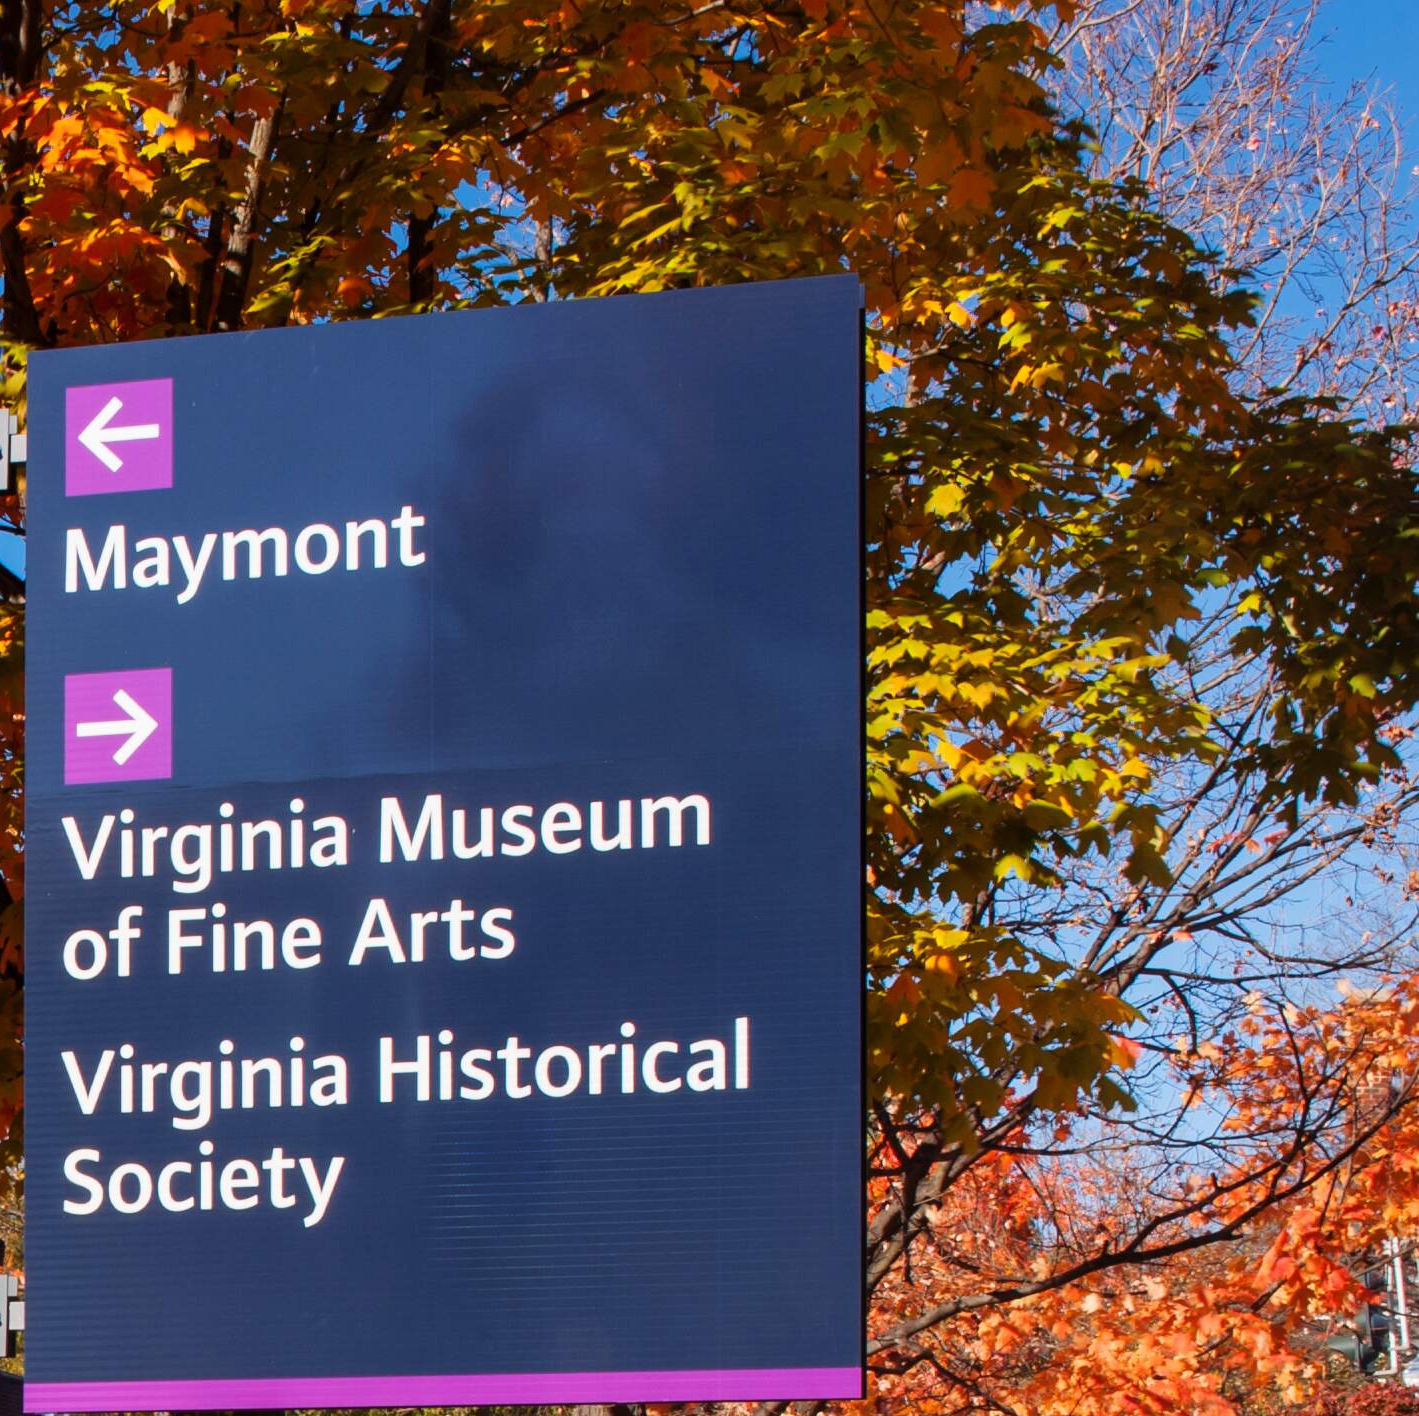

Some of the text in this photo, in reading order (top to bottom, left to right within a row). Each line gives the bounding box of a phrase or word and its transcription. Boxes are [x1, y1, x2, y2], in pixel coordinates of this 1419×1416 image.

[65, 505, 426, 605] Maymont
[61, 794, 711, 894] Virginia Museum
[63, 898, 515, 980] of Fine Arts
[60, 1016, 750, 1131] Virginia Historical
[62, 1140, 346, 1228] Society
